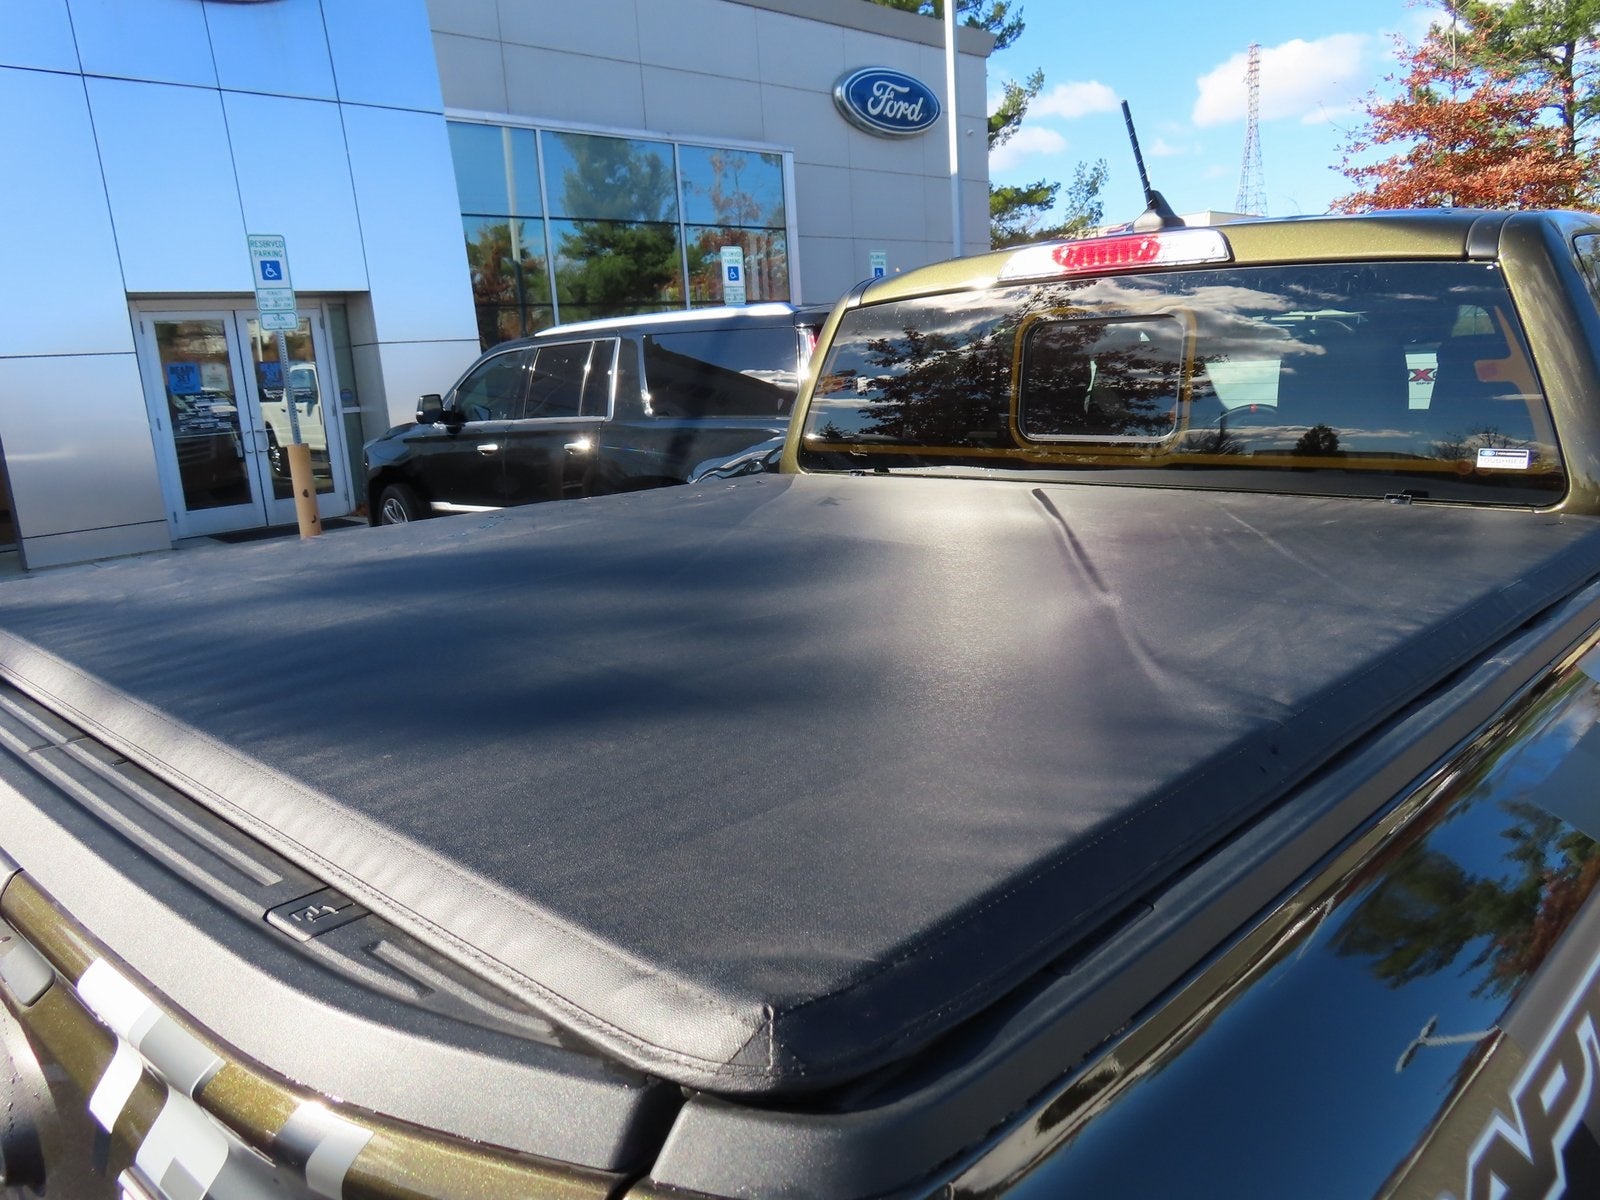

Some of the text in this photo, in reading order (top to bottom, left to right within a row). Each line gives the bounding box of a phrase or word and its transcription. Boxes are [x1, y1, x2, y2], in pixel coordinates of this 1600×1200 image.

[867, 80, 924, 122] Ford
[249, 240, 284, 249] RESERVED
[254, 250, 283, 258] PARKING
